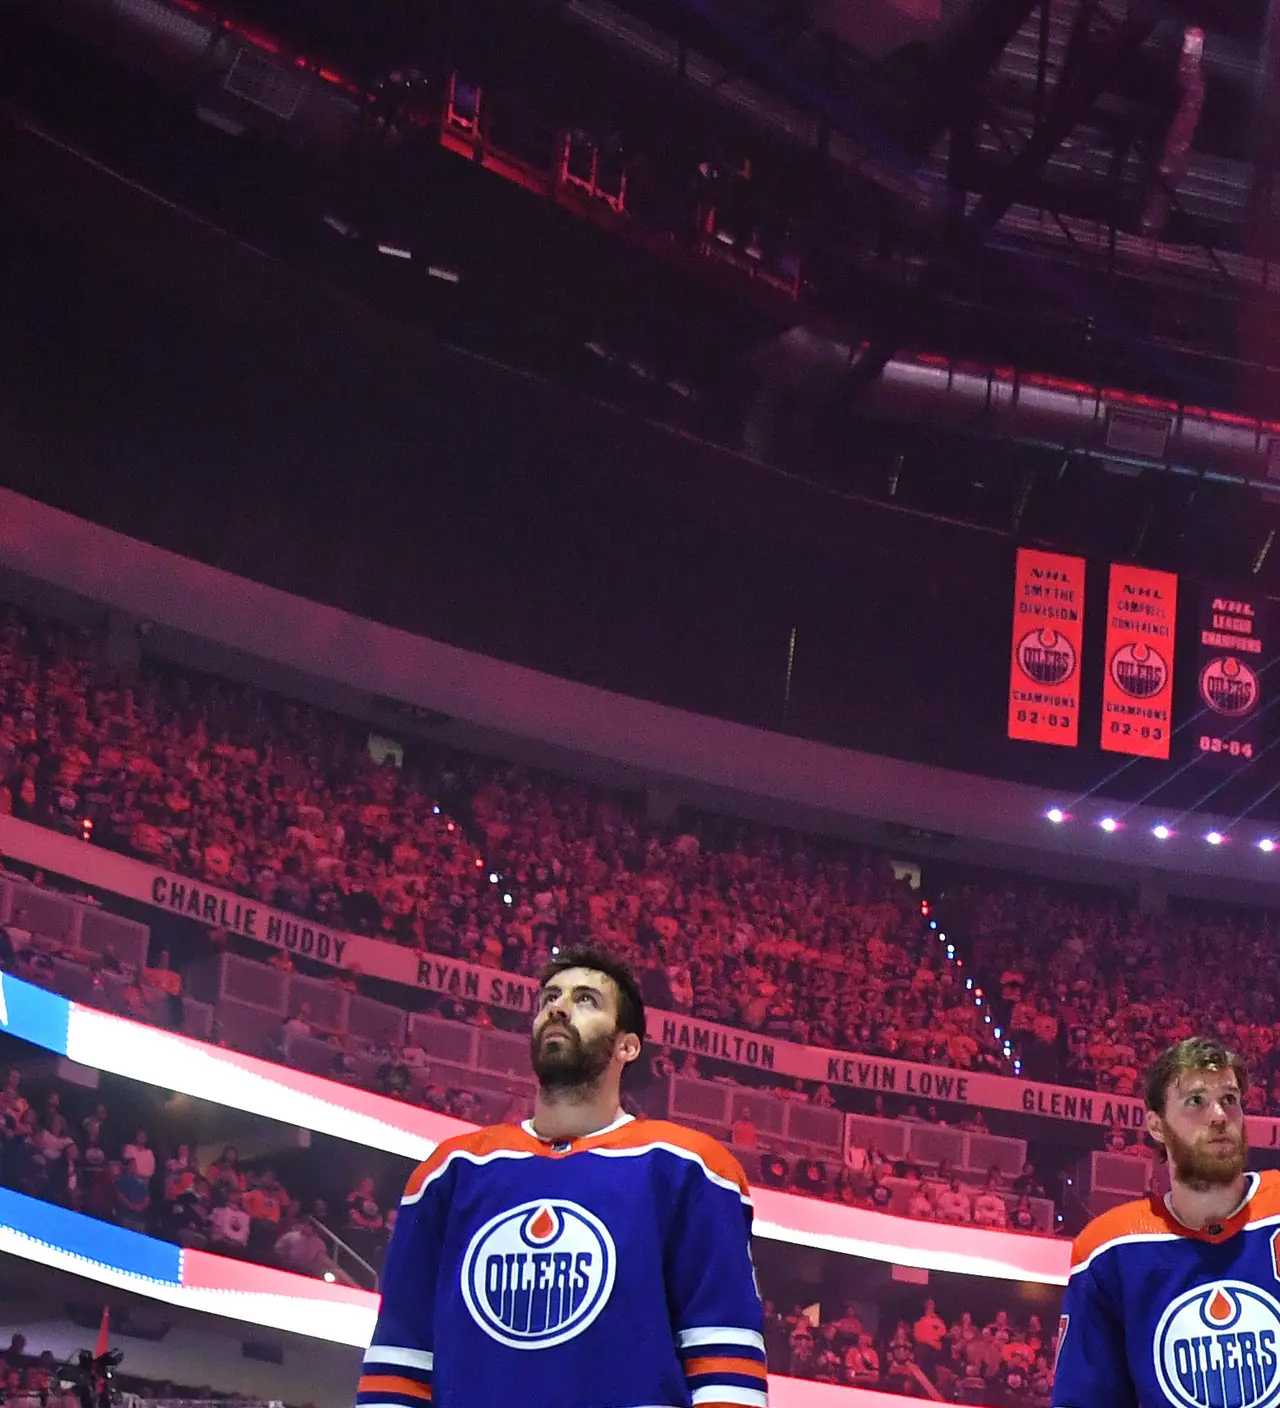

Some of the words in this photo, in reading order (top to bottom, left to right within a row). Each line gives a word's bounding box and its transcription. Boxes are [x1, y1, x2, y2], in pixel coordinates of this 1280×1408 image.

[1023, 645, 1069, 671] OILERS
[1116, 658, 1161, 685] OILERS
[1207, 676, 1252, 699] OILERS
[152, 876, 257, 934] CHARLIE
[267, 914, 347, 963] HUDDY
[417, 959, 479, 1001] RYAN
[663, 1019, 775, 1067] HAMILTON
[826, 1057, 896, 1092] KEVIN
[905, 1073, 968, 1101] LOWE
[1022, 1088, 1092, 1120] GLENN
